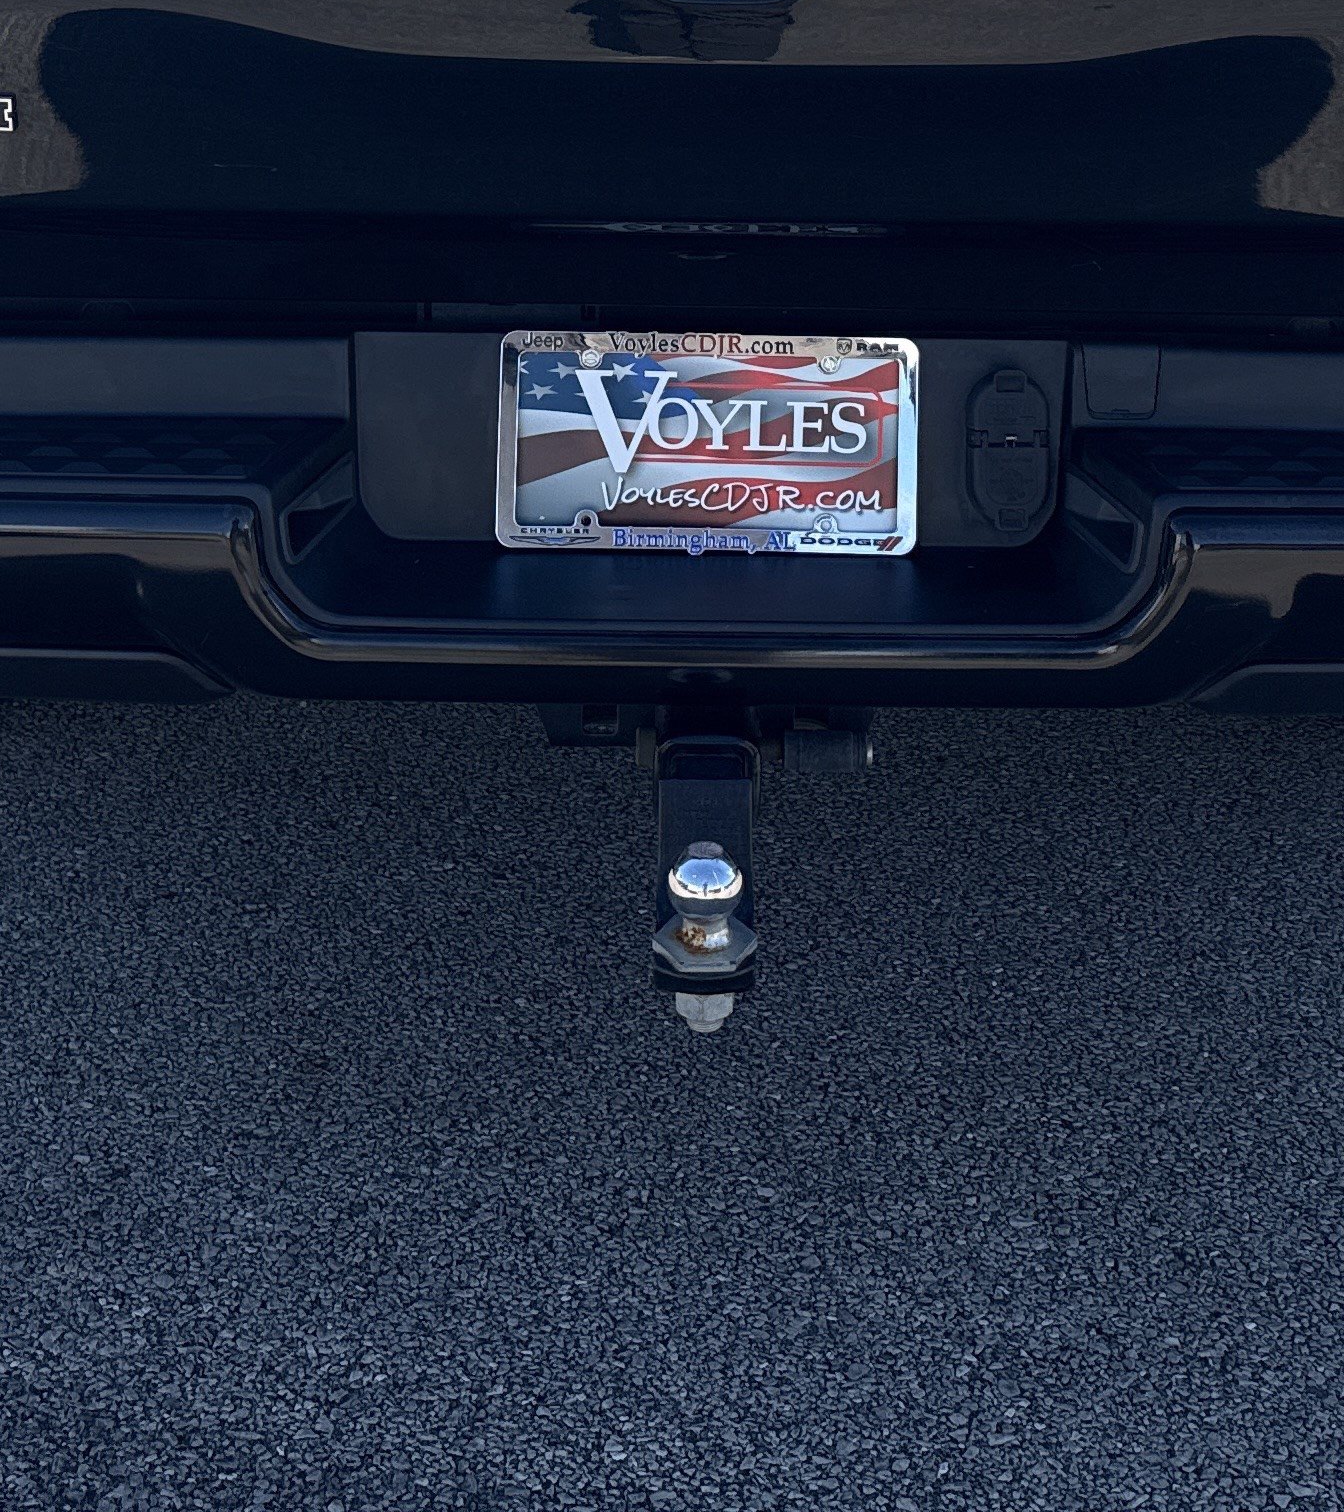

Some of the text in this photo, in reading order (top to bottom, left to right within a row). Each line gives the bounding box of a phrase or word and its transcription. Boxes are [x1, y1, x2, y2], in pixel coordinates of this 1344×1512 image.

[522, 332, 564, 350] Jeep
[608, 333, 795, 357] VoylesCDJR.com
[575, 368, 868, 474] VOYLES
[612, 528, 797, 555] Birmingham, AL
